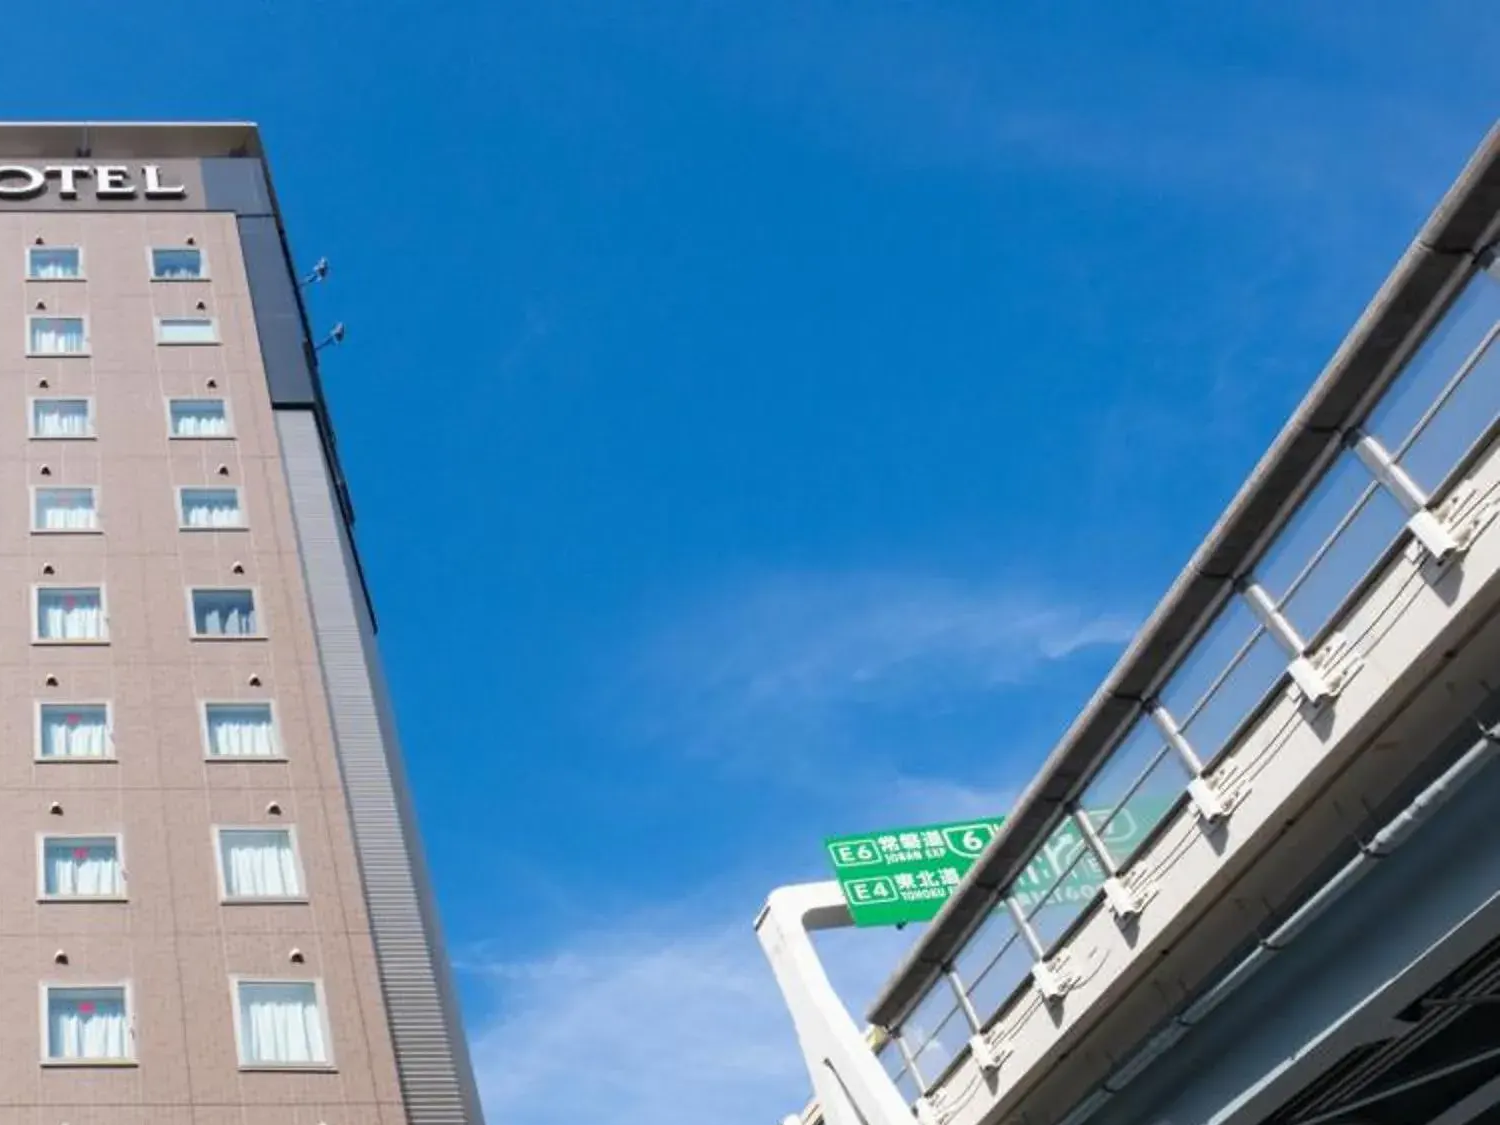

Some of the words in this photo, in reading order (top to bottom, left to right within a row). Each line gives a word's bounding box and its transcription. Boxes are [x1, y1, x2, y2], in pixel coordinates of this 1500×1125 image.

[962, 830, 984, 851] 6
[838, 844, 873, 863] E6
[853, 882, 889, 900] E4
